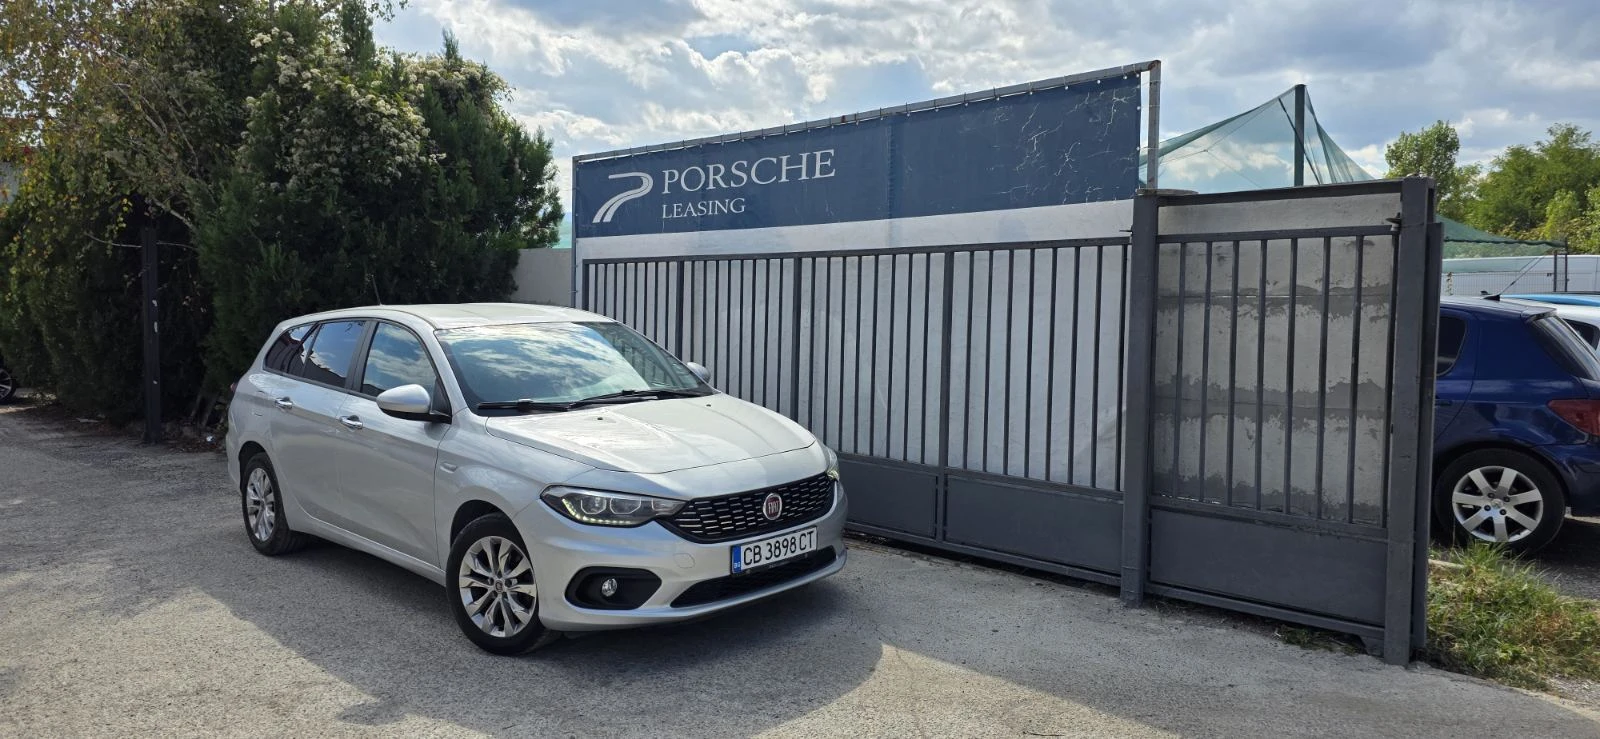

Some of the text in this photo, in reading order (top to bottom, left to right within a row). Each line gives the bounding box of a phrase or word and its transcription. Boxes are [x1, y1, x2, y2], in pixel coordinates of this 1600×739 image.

[661, 149, 836, 194] PORSCHE
[662, 198, 745, 219] LEASING
[744, 545, 762, 565] CB
[765, 536, 797, 561] 3898
[799, 531, 814, 551] CT
